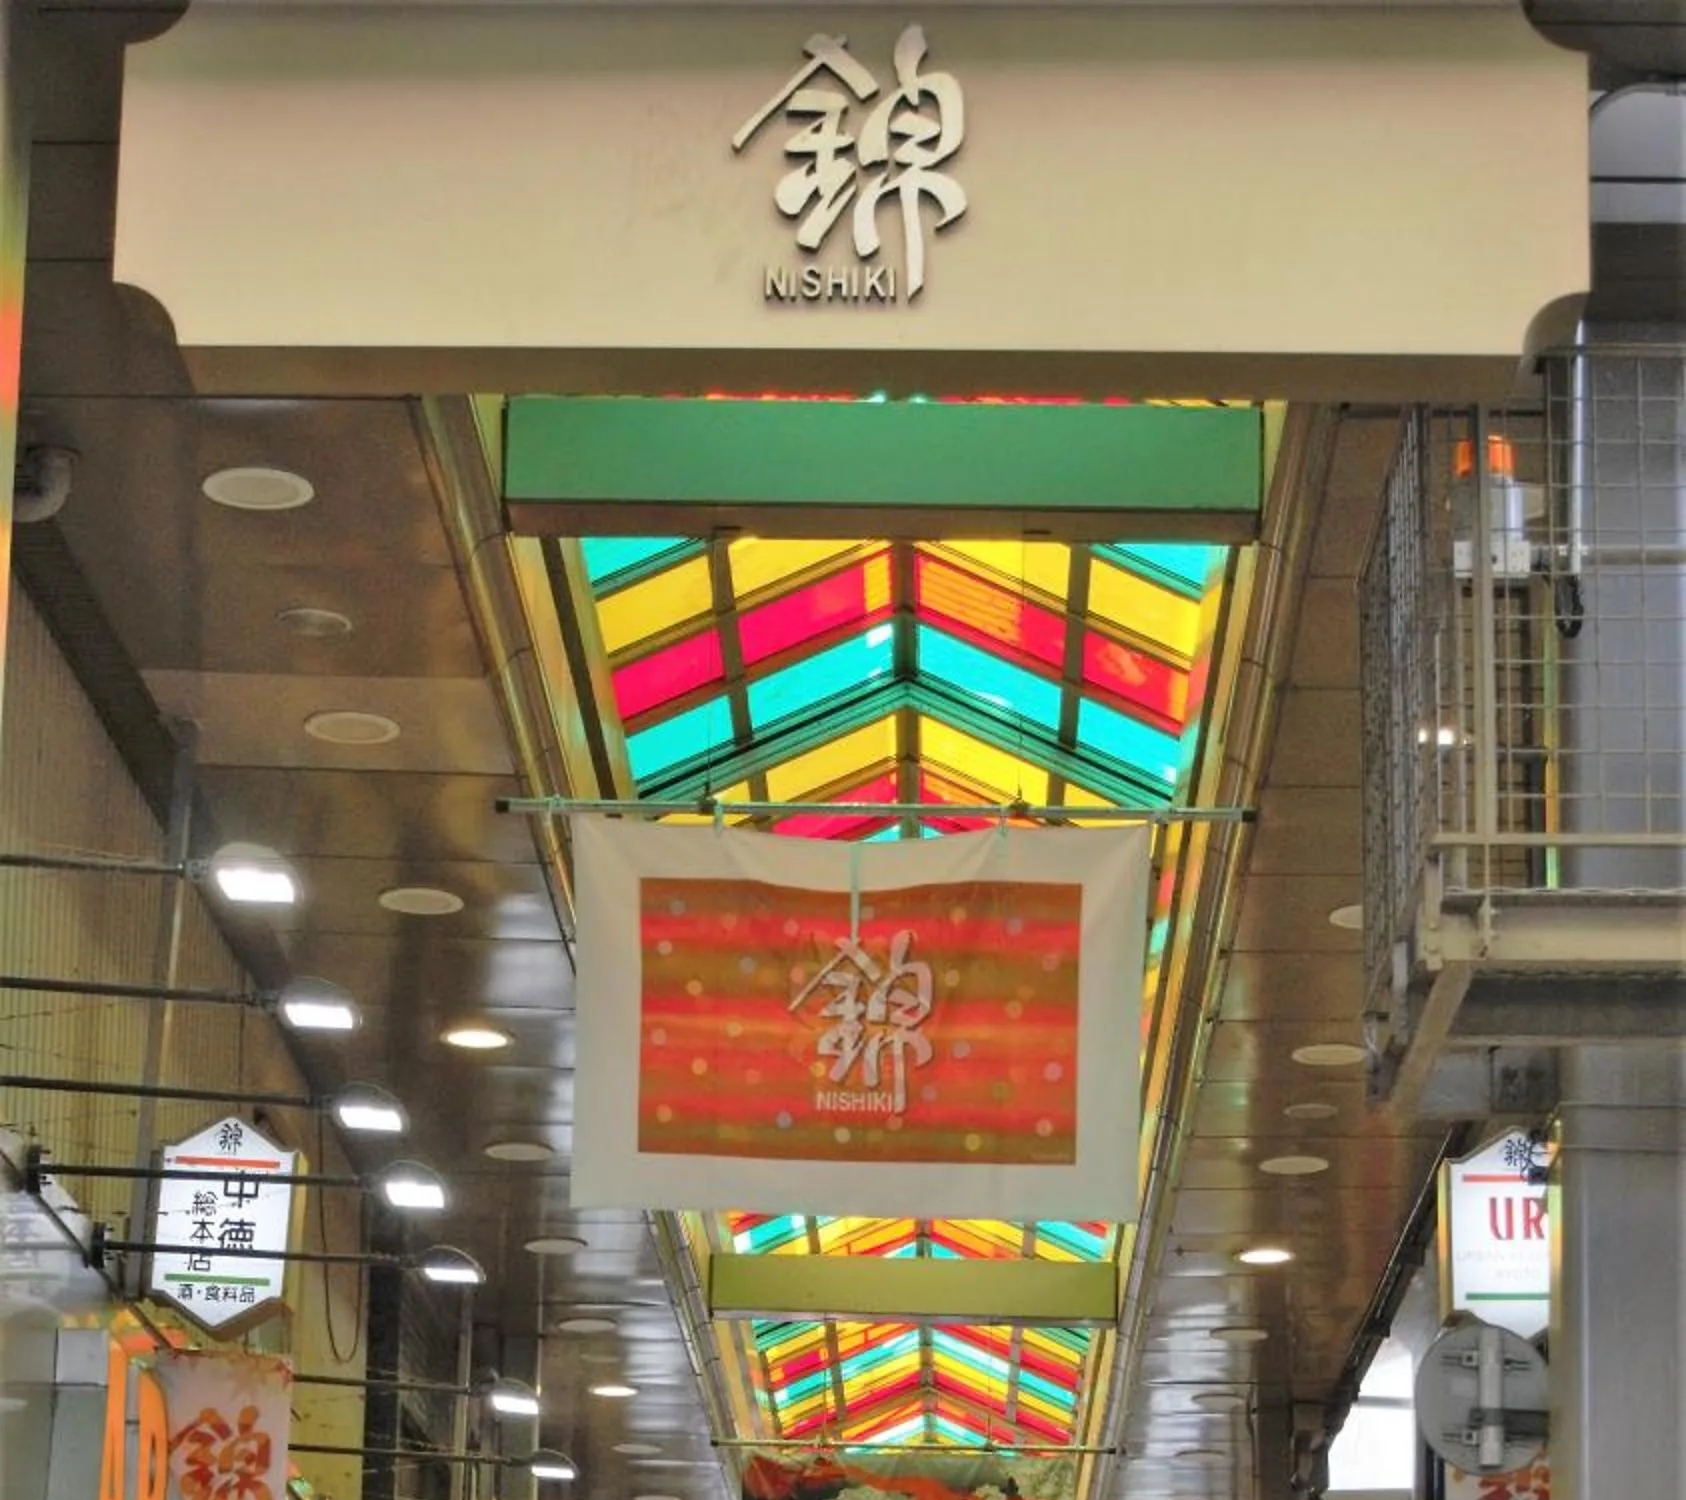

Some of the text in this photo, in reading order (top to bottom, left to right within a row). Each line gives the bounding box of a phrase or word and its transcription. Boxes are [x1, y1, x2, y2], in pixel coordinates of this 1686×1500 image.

[732, 23, 968, 304] 錦
[764, 265, 898, 301] NISHIKI
[788, 929, 934, 1115] 錦
[815, 1091, 893, 1113] NISHIKI
